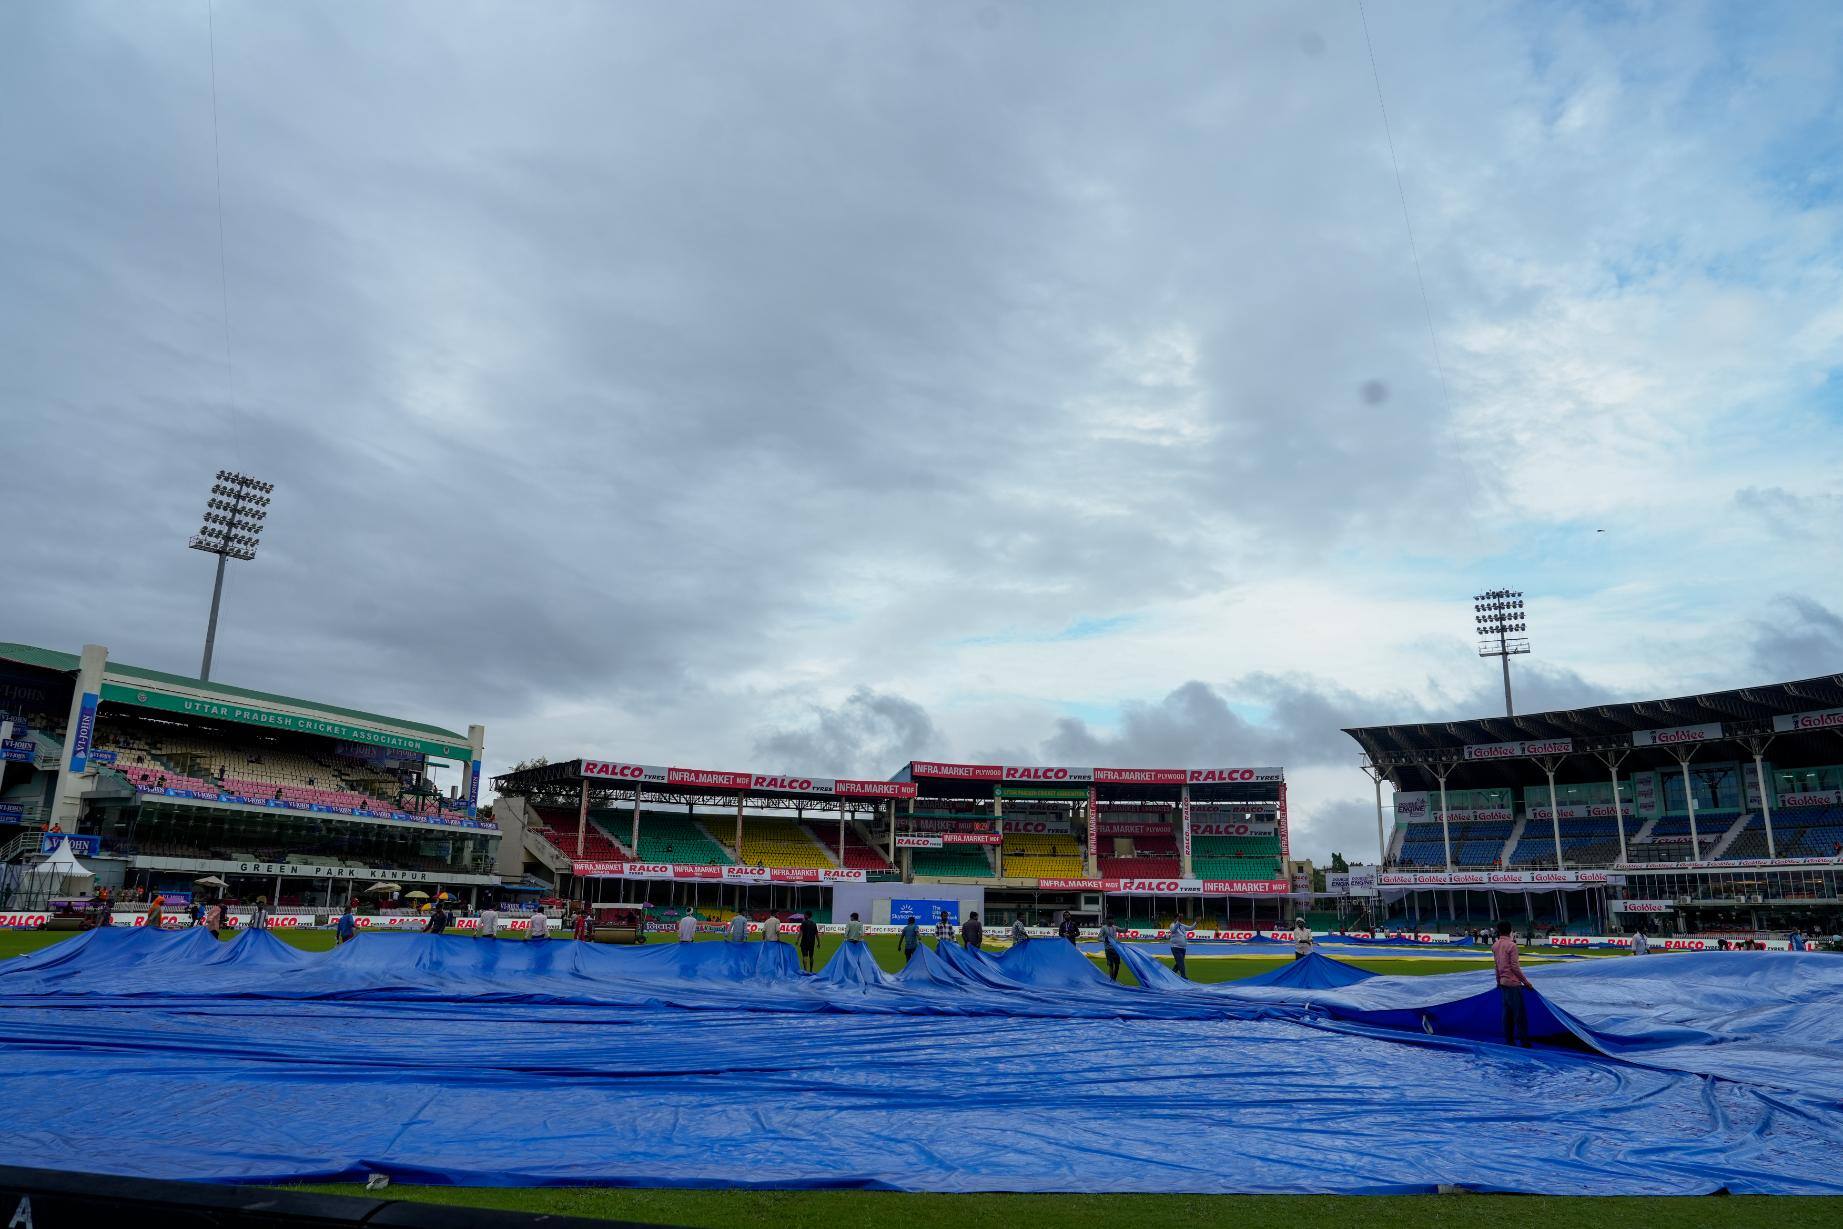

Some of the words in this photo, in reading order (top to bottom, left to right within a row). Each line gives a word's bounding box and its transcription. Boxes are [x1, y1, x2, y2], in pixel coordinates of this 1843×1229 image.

[184, 701, 228, 716] UTTAR
[234, 709, 292, 726] PRADESH
[298, 720, 348, 735] CRICKET
[351, 730, 421, 750] ASSOCIATION
[1801, 714, 1843, 727] Goldie
[77, 715, 91, 752] VI-JOHN
[1658, 730, 1705, 743] Goldiee
[1473, 747, 1515, 758] Goldiee
[1526, 743, 1570, 755] Goldiee
[584, 762, 644, 779] RALCO
[914, 764, 973, 776] INFRA.MARKET
[1005, 767, 1068, 780] RALCO
[1095, 770, 1155, 781] INFRA.MARKET
[1189, 769, 1254, 782] RALCO
[669, 771, 735, 785] INFRA.MARKET
[736, 777, 750, 785] MDF
[754, 776, 813, 791] RALCO
[836, 782, 900, 794] INFRA.MARKET
[901, 786, 915, 794] MDF
[1786, 795, 1831, 806] Goldiee
[1478, 811, 1512, 821] Goldiee
[1003, 821, 1046, 833] ALCO
[1191, 824, 1248, 835] RALCO
[897, 838, 930, 846] RALCO
[943, 834, 988, 843] INFRA.MARKET
[240, 863, 298, 873] GREEN
[315, 867, 355, 876] PARK
[370, 871, 427, 880] KANPUR
[574, 863, 622, 871] INFRA.MARKET
[629, 864, 668, 873] RALCO
[674, 865, 721, 873] INFRA.MARKET
[727, 867, 766, 875] RALCO
[771, 869, 817, 877] INFRA.MARKET
[823, 870, 862, 878] RALCO
[1491, 873, 1523, 882] Goldiee
[1535, 873, 1567, 881] Goldiee
[1579, 872, 1607, 881] Goldie
[1040, 880, 1102, 888] INFRA.MARKET
[1122, 881, 1179, 892] RALCO
[1204, 882, 1269, 892] INFRA.MARKET
[1272, 883, 1286, 891] MDF
[1628, 902, 1663, 912] Goldiee
[267, 917, 298, 927] ALCO
[1551, 937, 1589, 945] RALCO
[1664, 940, 1705, 950] RALCO
